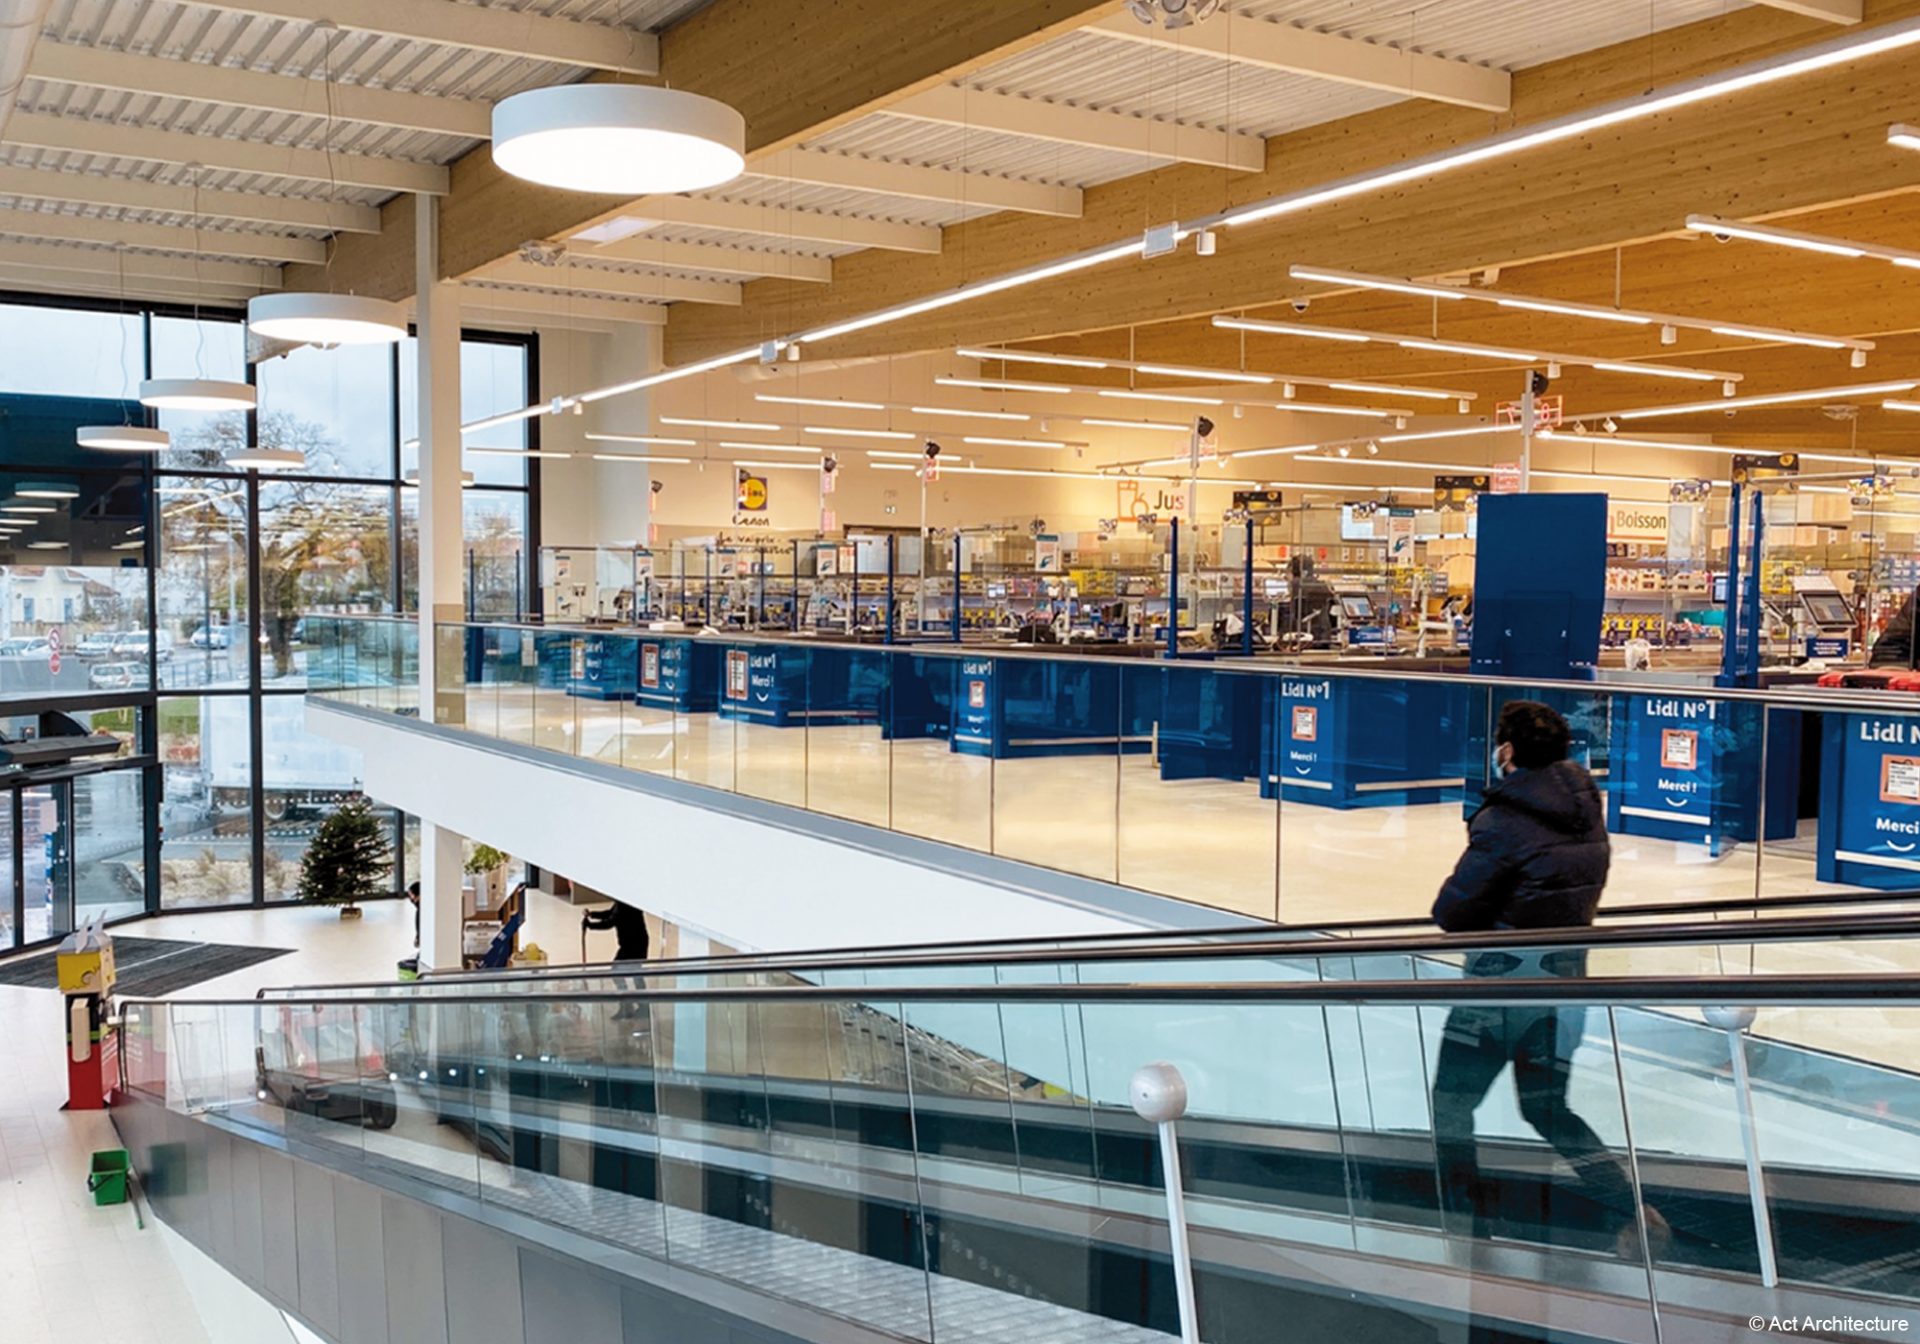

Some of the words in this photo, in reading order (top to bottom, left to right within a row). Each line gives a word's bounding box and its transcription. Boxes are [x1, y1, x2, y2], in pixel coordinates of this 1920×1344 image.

[1153, 490, 1185, 510] Jus
[1616, 510, 1666, 529] Boisson
[1282, 682, 1304, 698] Lidl
[1307, 681, 1330, 700] N°1
[1646, 699, 1679, 717] Lidl
[1683, 699, 1716, 720] N°1
[1860, 721, 1904, 743] Lidl
[1876, 817, 1920, 834] Merci
